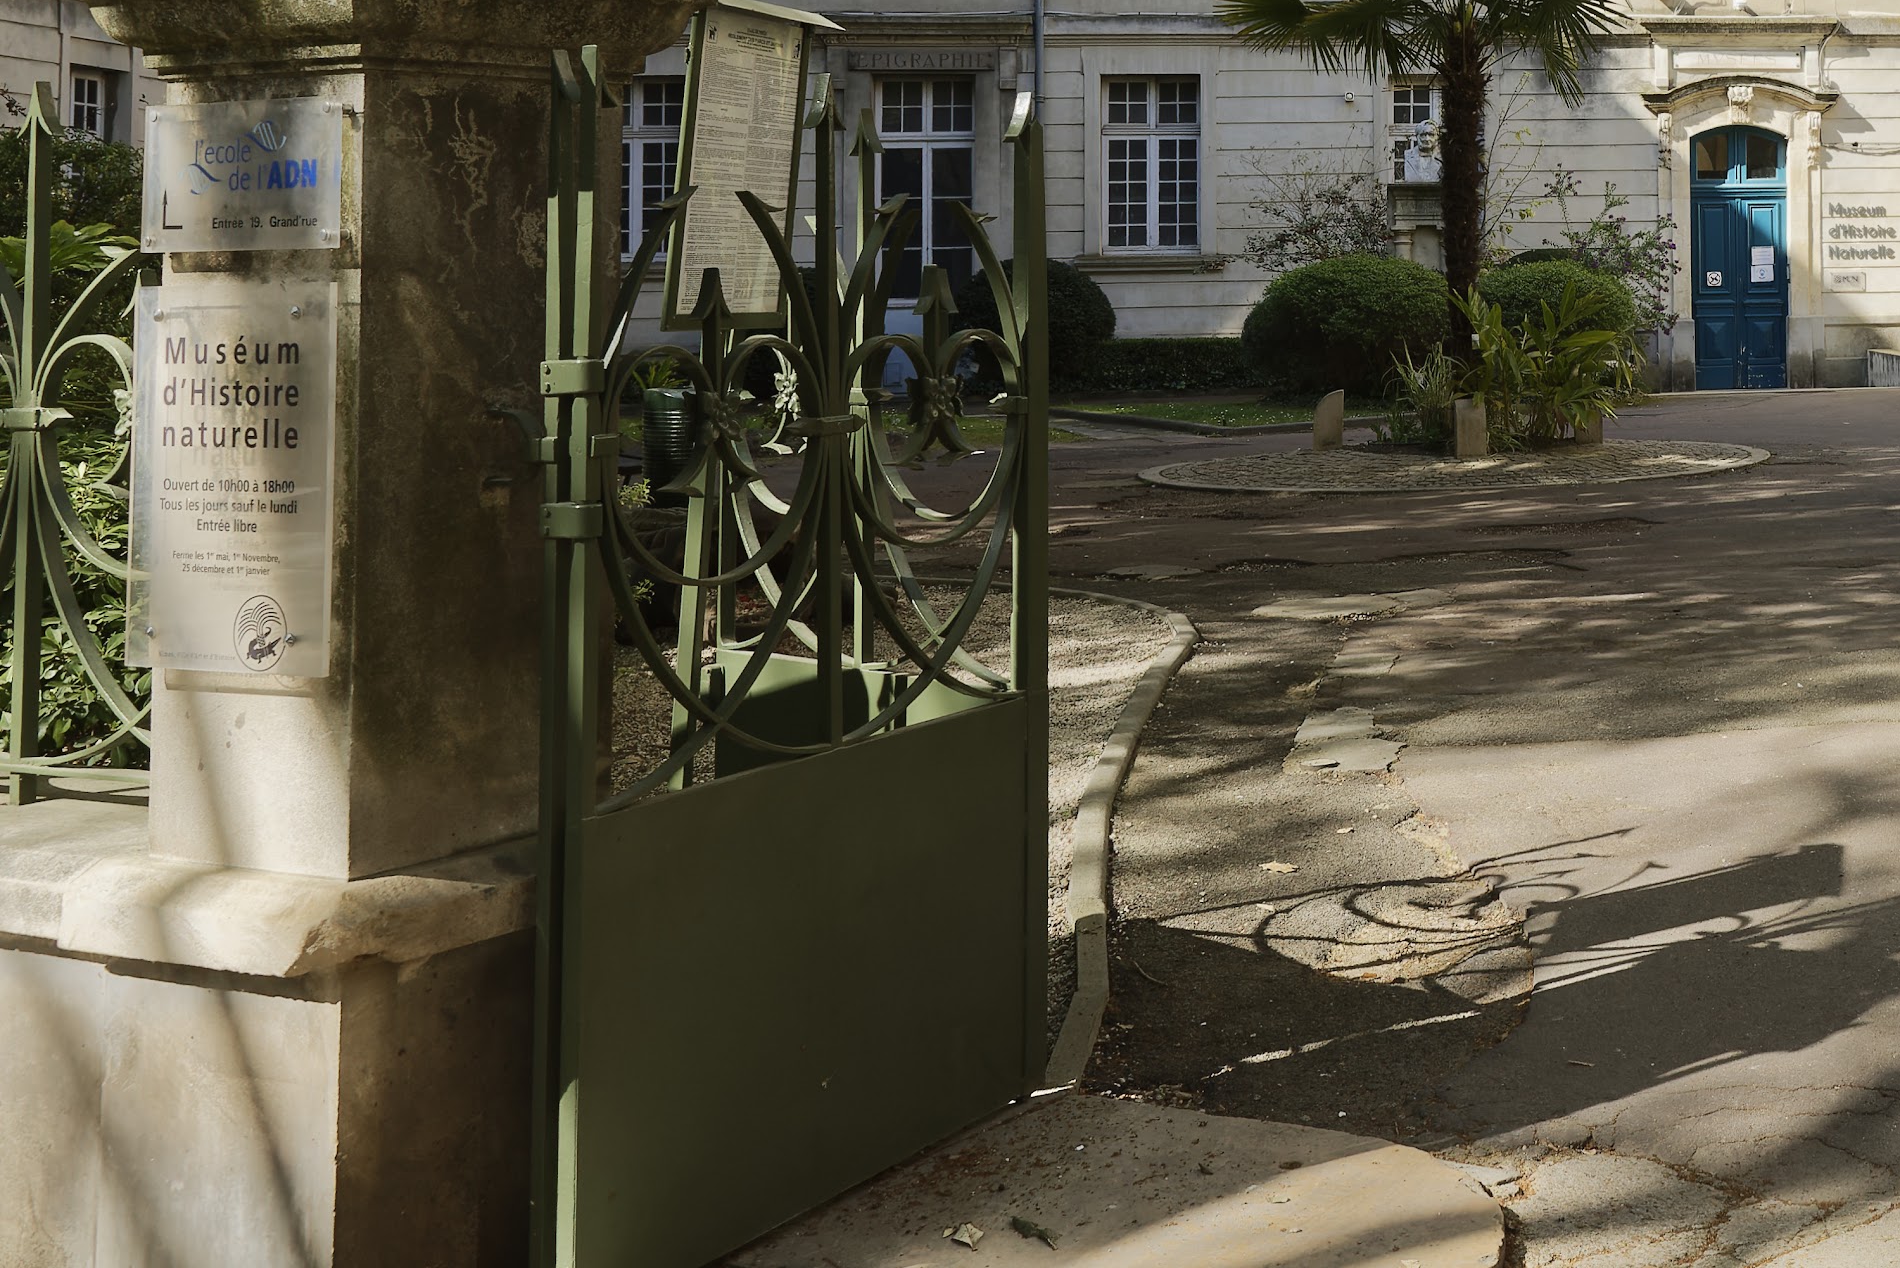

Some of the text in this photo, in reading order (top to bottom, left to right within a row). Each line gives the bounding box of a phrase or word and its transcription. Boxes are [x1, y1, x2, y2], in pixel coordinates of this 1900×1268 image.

[857, 52, 985, 69] EPIGRAPHIE
[229, 158, 318, 191] de l'ADN
[269, 215, 318, 228] Grand'rue
[1828, 223, 1897, 240] d'Histoire
[1828, 244, 1896, 261] Naturelle
[165, 335, 300, 365] Muséum
[163, 376, 299, 407] d'Histoire
[162, 418, 298, 449] naturelle
[163, 478, 295, 494] Ouvert de 10h00 à 18h00
[160, 498, 298, 514] Tous les jours sauf le lundi
[196, 518, 257, 533] Entrée libre
[195, 551, 204, 560] les
[182, 563, 190, 572] 25
[227, 565, 234, 574] et
[245, 566, 270, 577] janvier
